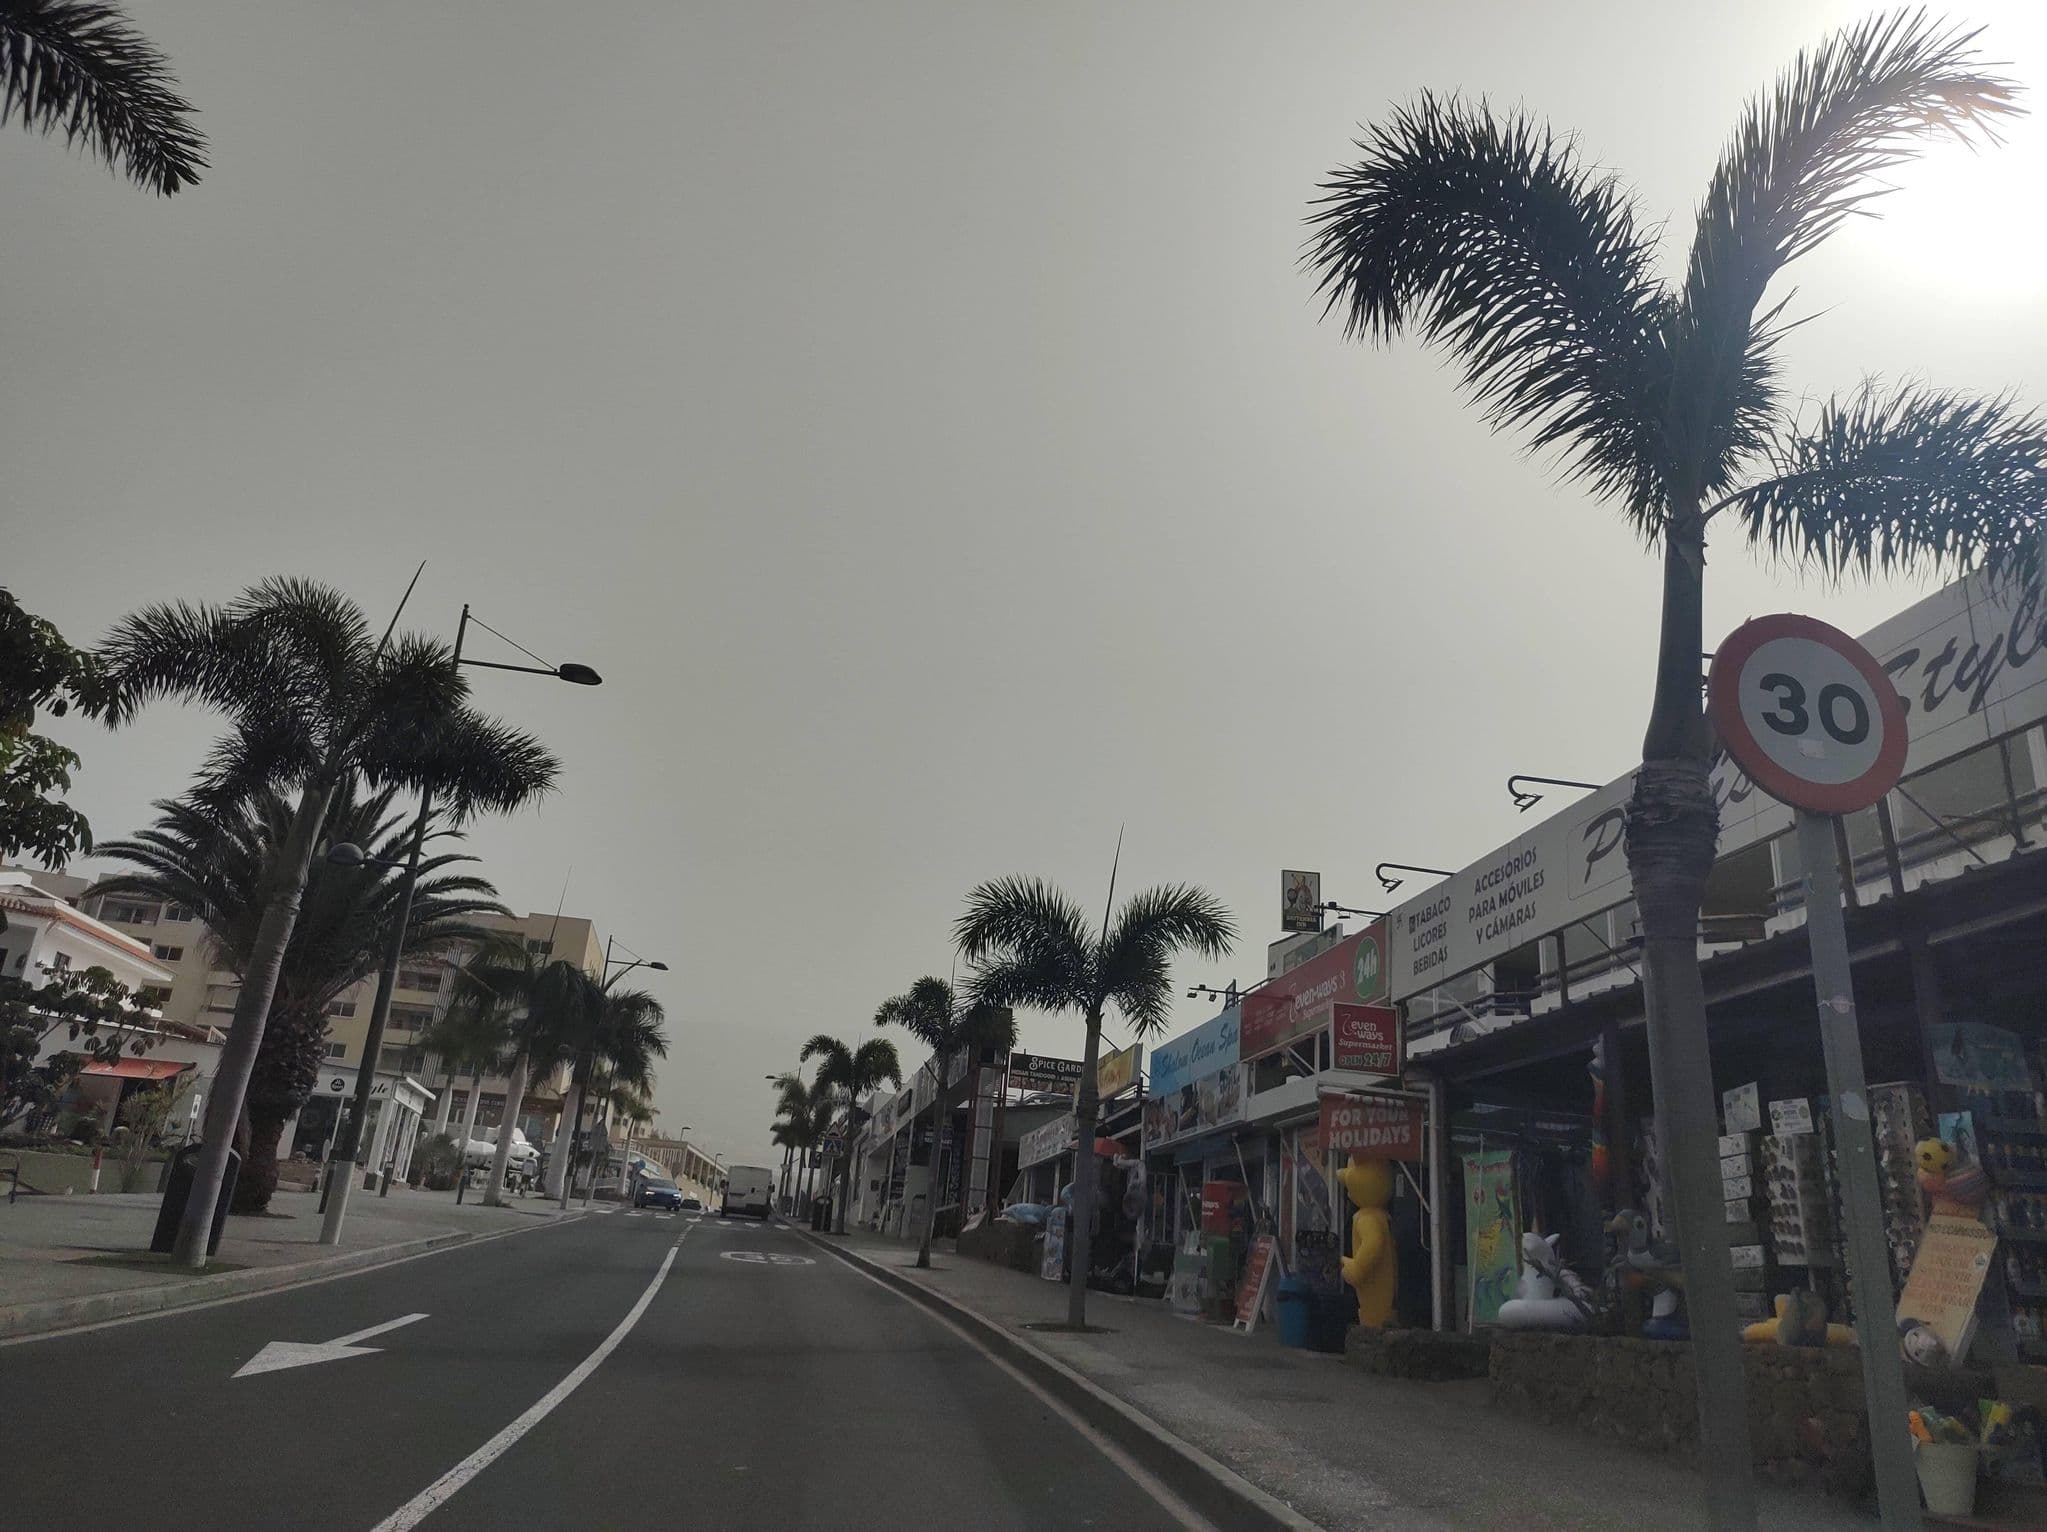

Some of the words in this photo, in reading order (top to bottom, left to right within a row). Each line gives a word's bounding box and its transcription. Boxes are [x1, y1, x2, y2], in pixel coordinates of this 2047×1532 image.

[1760, 673, 1870, 745] 30
[1474, 846, 1537, 896] ACCESORIOS
[1469, 897, 1497, 923] PARA
[1499, 869, 1545, 909] MÓVILES
[1416, 896, 1451, 928] TABACO
[1475, 928, 1483, 944] Y
[1485, 901, 1537, 941] CÁMARAS
[1413, 921, 1448, 952] LICORES
[1356, 948, 1378, 985] 24h
[1413, 946, 1448, 976] BEBIDAS
[1337, 1038, 1394, 1051] Supermarket
[1363, 1052, 1393, 1068] 24/7
[1057, 1061, 1084, 1073] GARD
[1330, 1107, 1362, 1128] FOR
[1367, 1105, 1409, 1125] YOUR
[1328, 1124, 1411, 1150] HOLIDAYS
